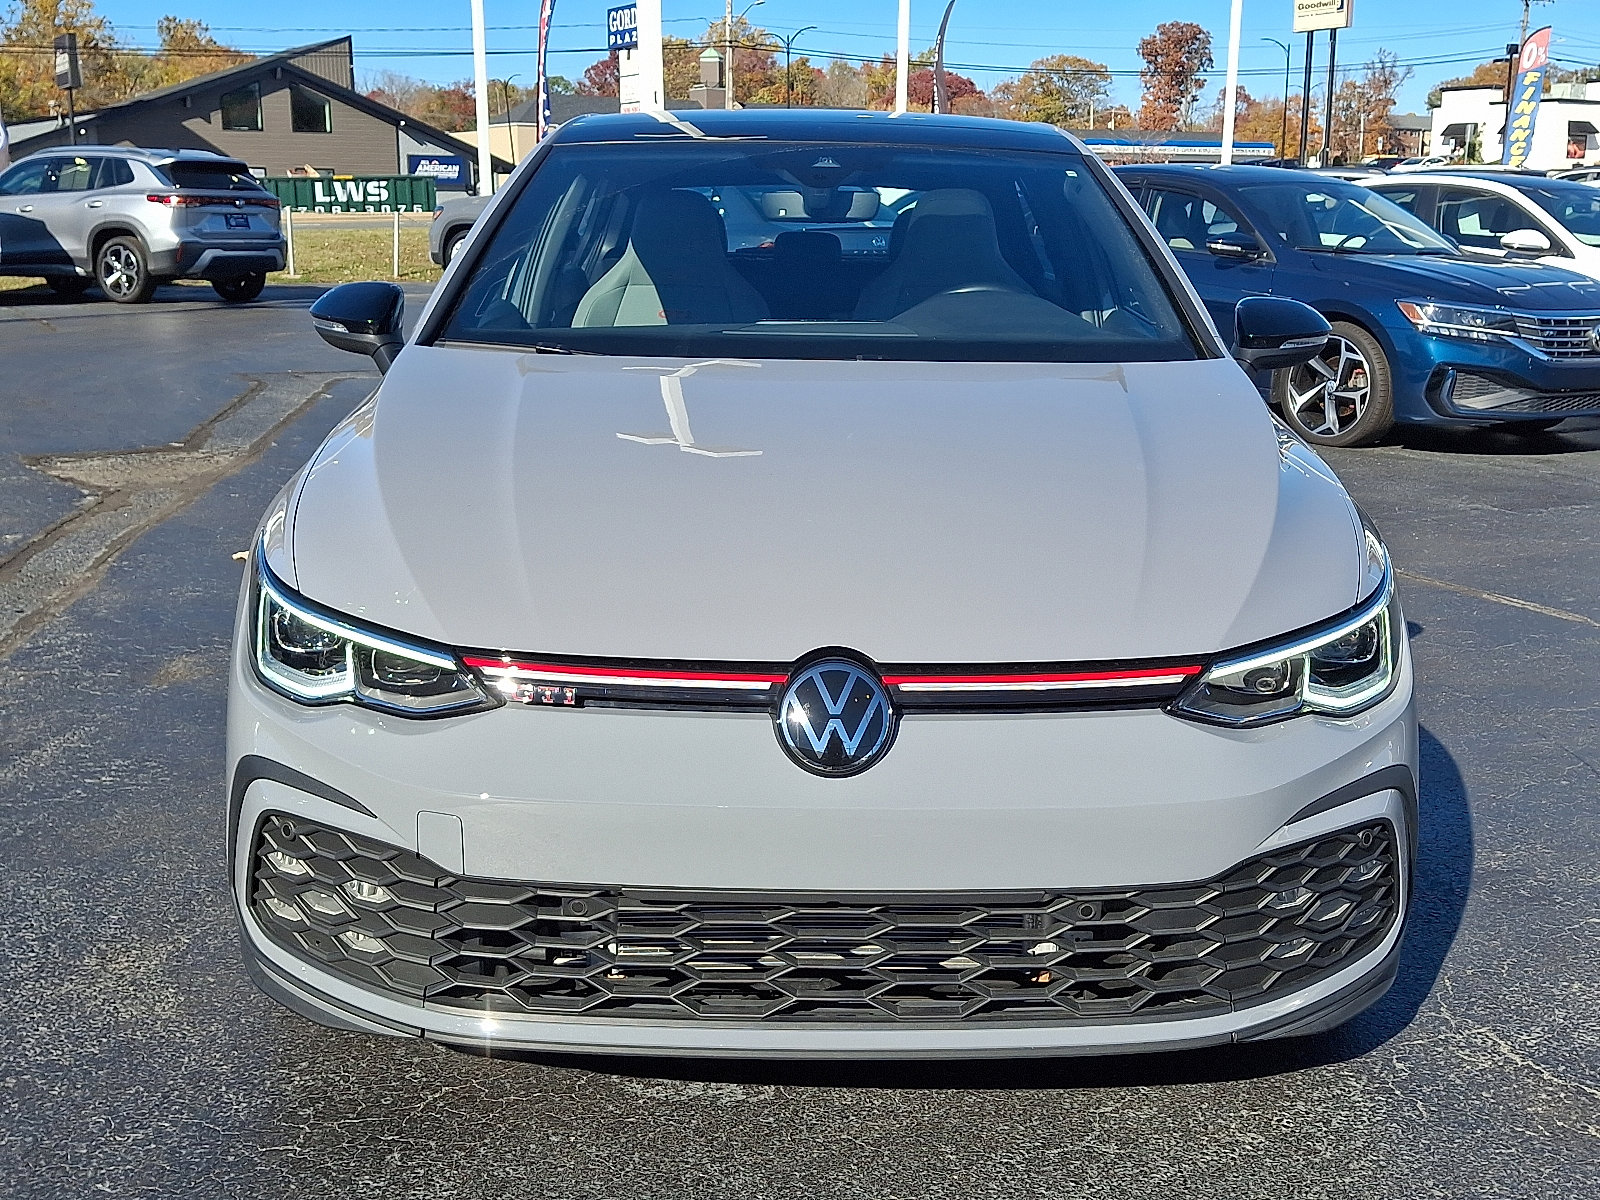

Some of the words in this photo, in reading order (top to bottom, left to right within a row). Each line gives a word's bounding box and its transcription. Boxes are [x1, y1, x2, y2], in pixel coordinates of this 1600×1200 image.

[1297, 0, 1336, 11] Goodwill
[1522, 41, 1546, 70] 0%
[1509, 71, 1541, 167] FINANCE
[416, 164, 460, 172] AMERICAN
[314, 180, 389, 203] LWS
[512, 683, 577, 706] GTI
[784, 663, 886, 764] VW
